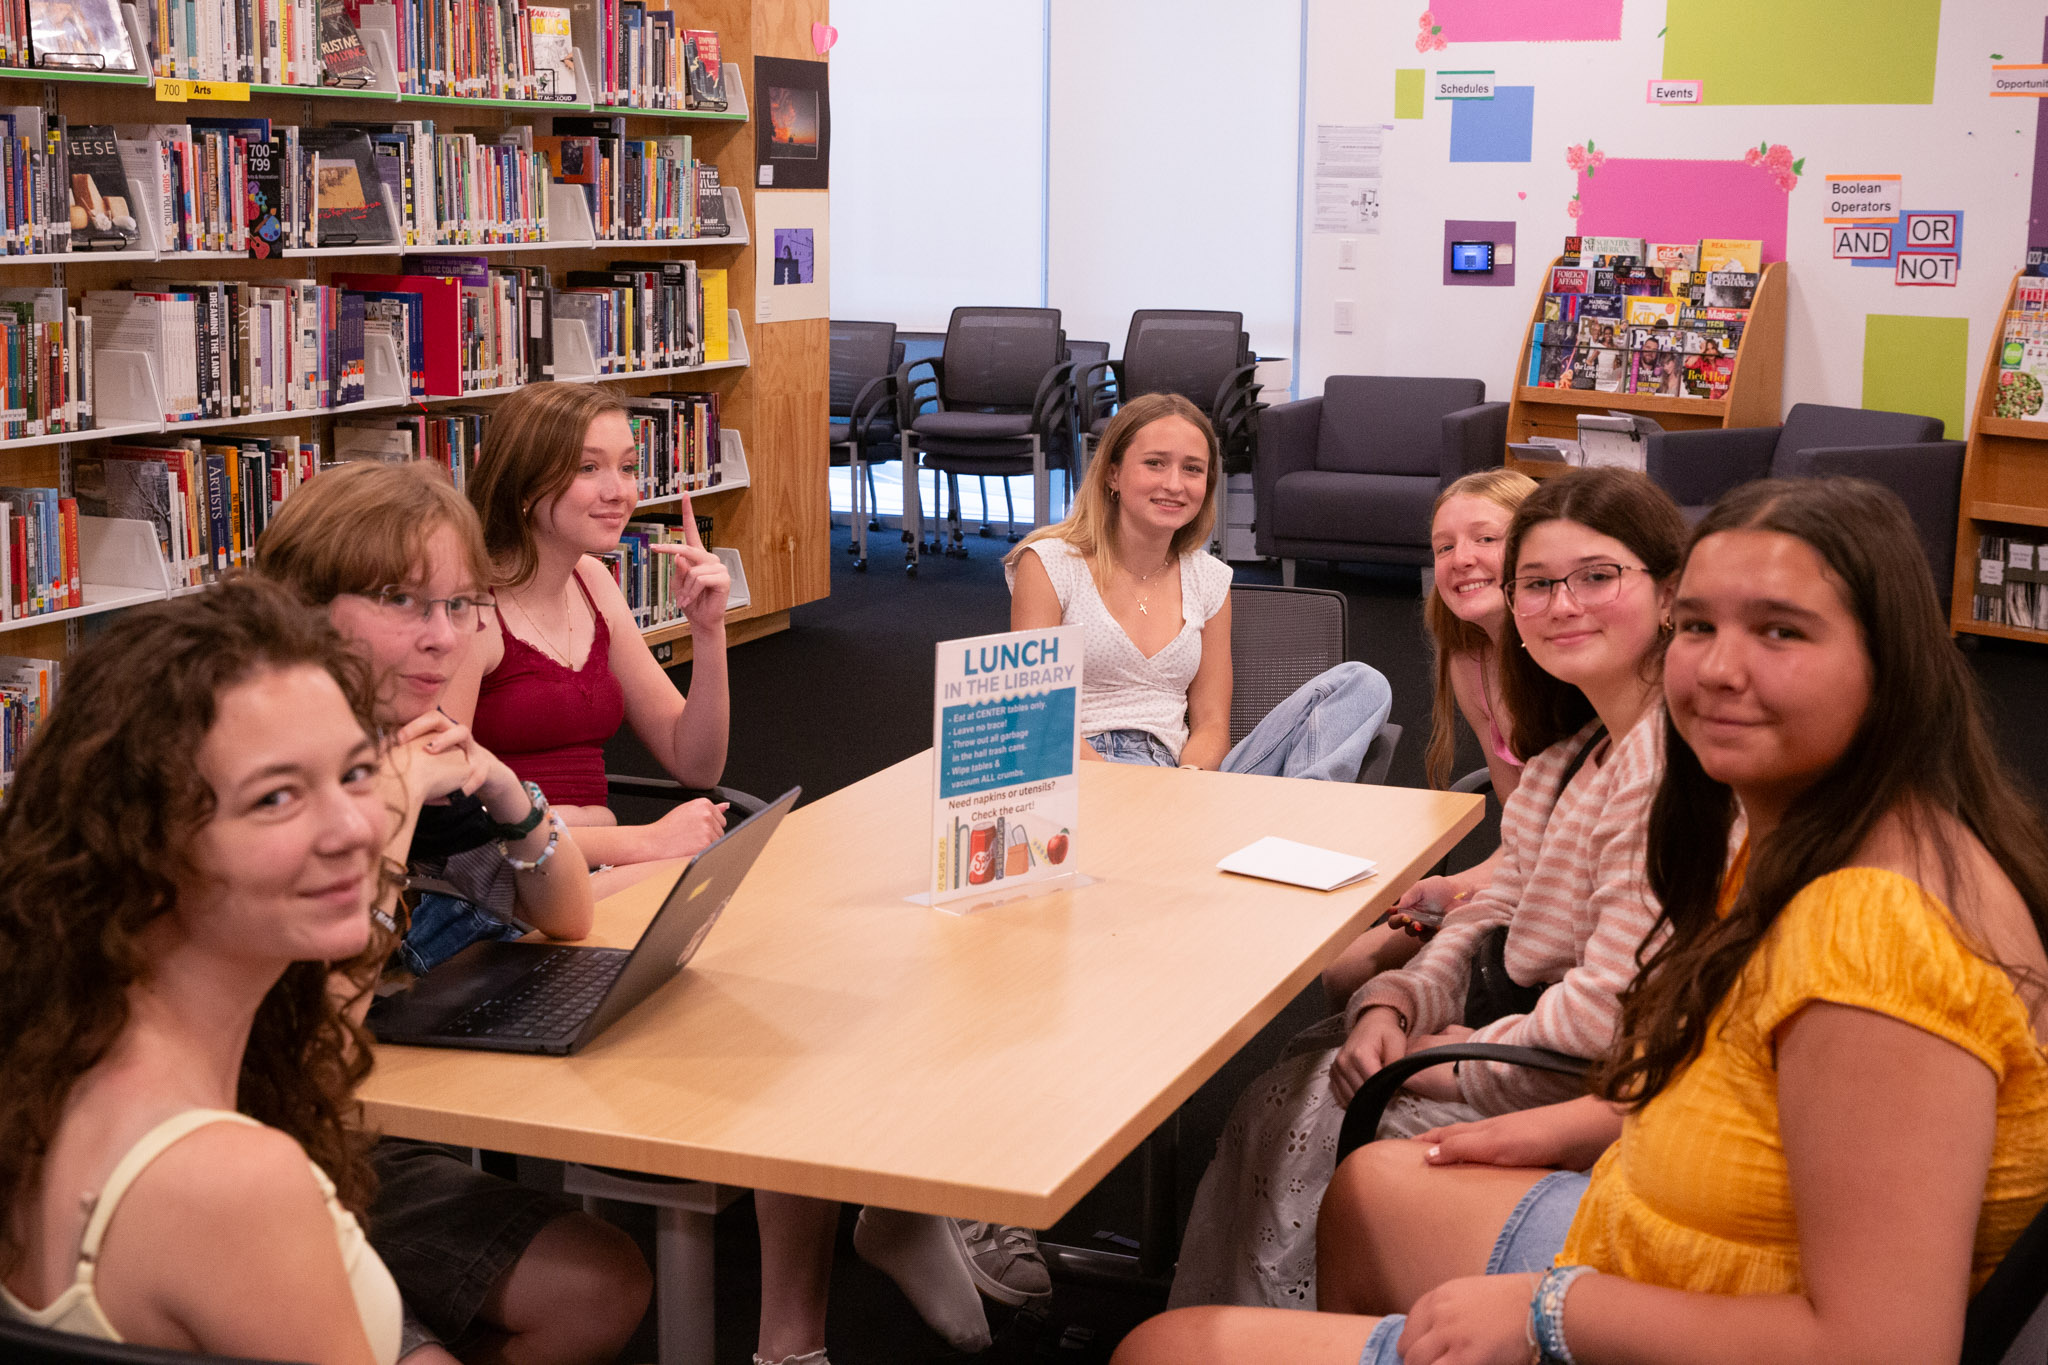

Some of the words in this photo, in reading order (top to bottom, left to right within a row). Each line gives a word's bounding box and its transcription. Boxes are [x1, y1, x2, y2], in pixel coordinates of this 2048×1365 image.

[531, 17, 570, 36] OMICS
[321, 38, 343, 55] RUST
[163, 84, 180, 96] 700
[193, 85, 211, 95] Arts
[1440, 83, 1489, 94] Schedules
[1656, 87, 1693, 100] Events
[68, 141, 116, 156] EESE
[249, 158, 271, 171] 799
[162, 173, 170, 194] SODA
[1832, 183, 1881, 194] Boolean
[163, 195, 172, 227] POLITICS
[1831, 202, 1891, 214] Operators
[1912, 220, 1950, 241] OR
[1836, 232, 1889, 253] AND
[1556, 270, 1586, 278] FOREIGN
[1712, 273, 1746, 281] POPULAR
[1900, 258, 1954, 280] NOT
[1558, 278, 1583, 286] AFFAIRS
[1712, 279, 1754, 287] MECHANICS
[209, 291, 219, 336] DREAMING
[211, 337, 219, 354] THE
[211, 355, 220, 379] LAND
[209, 465, 222, 520] ARTISTS
[199, 475, 207, 536] MICHELANGELO
[964, 637, 1059, 676] LUNCH
[944, 681, 962, 700] IN
[966, 676, 1000, 695] THE
[1004, 664, 1075, 690] LIBRARY
[953, 714, 966, 723] Eat
[976, 706, 1006, 719] CENTER
[1007, 703, 1029, 714] tables
[1030, 701, 1047, 711] only.
[953, 726, 975, 736] Leave
[987, 719, 1008, 730] trace!
[953, 739, 975, 749] Throw
[976, 736, 989, 744] out
[990, 734, 999, 743] all
[1000, 730, 1029, 743] garbage
[952, 754, 960, 762] in
[961, 751, 972, 761] the
[974, 748, 988, 759] hall
[989, 746, 1007, 756] trash
[1008, 743, 1027, 753] cans.
[951, 766, 970, 776] Wipe
[971, 761, 993, 772] tables
[994, 759, 1000, 767] &
[951, 777, 980, 788] vacuum
[981, 773, 995, 784] ALL
[996, 769, 1025, 780] crumbs.
[948, 797, 971, 810] Need
[973, 792, 1006, 808] napkins
[1008, 789, 1017, 798] or
[1019, 781, 1056, 796] utensils?
[971, 808, 997, 822] Check
[999, 805, 1014, 816] the
[1015, 801, 1035, 813] cart!
